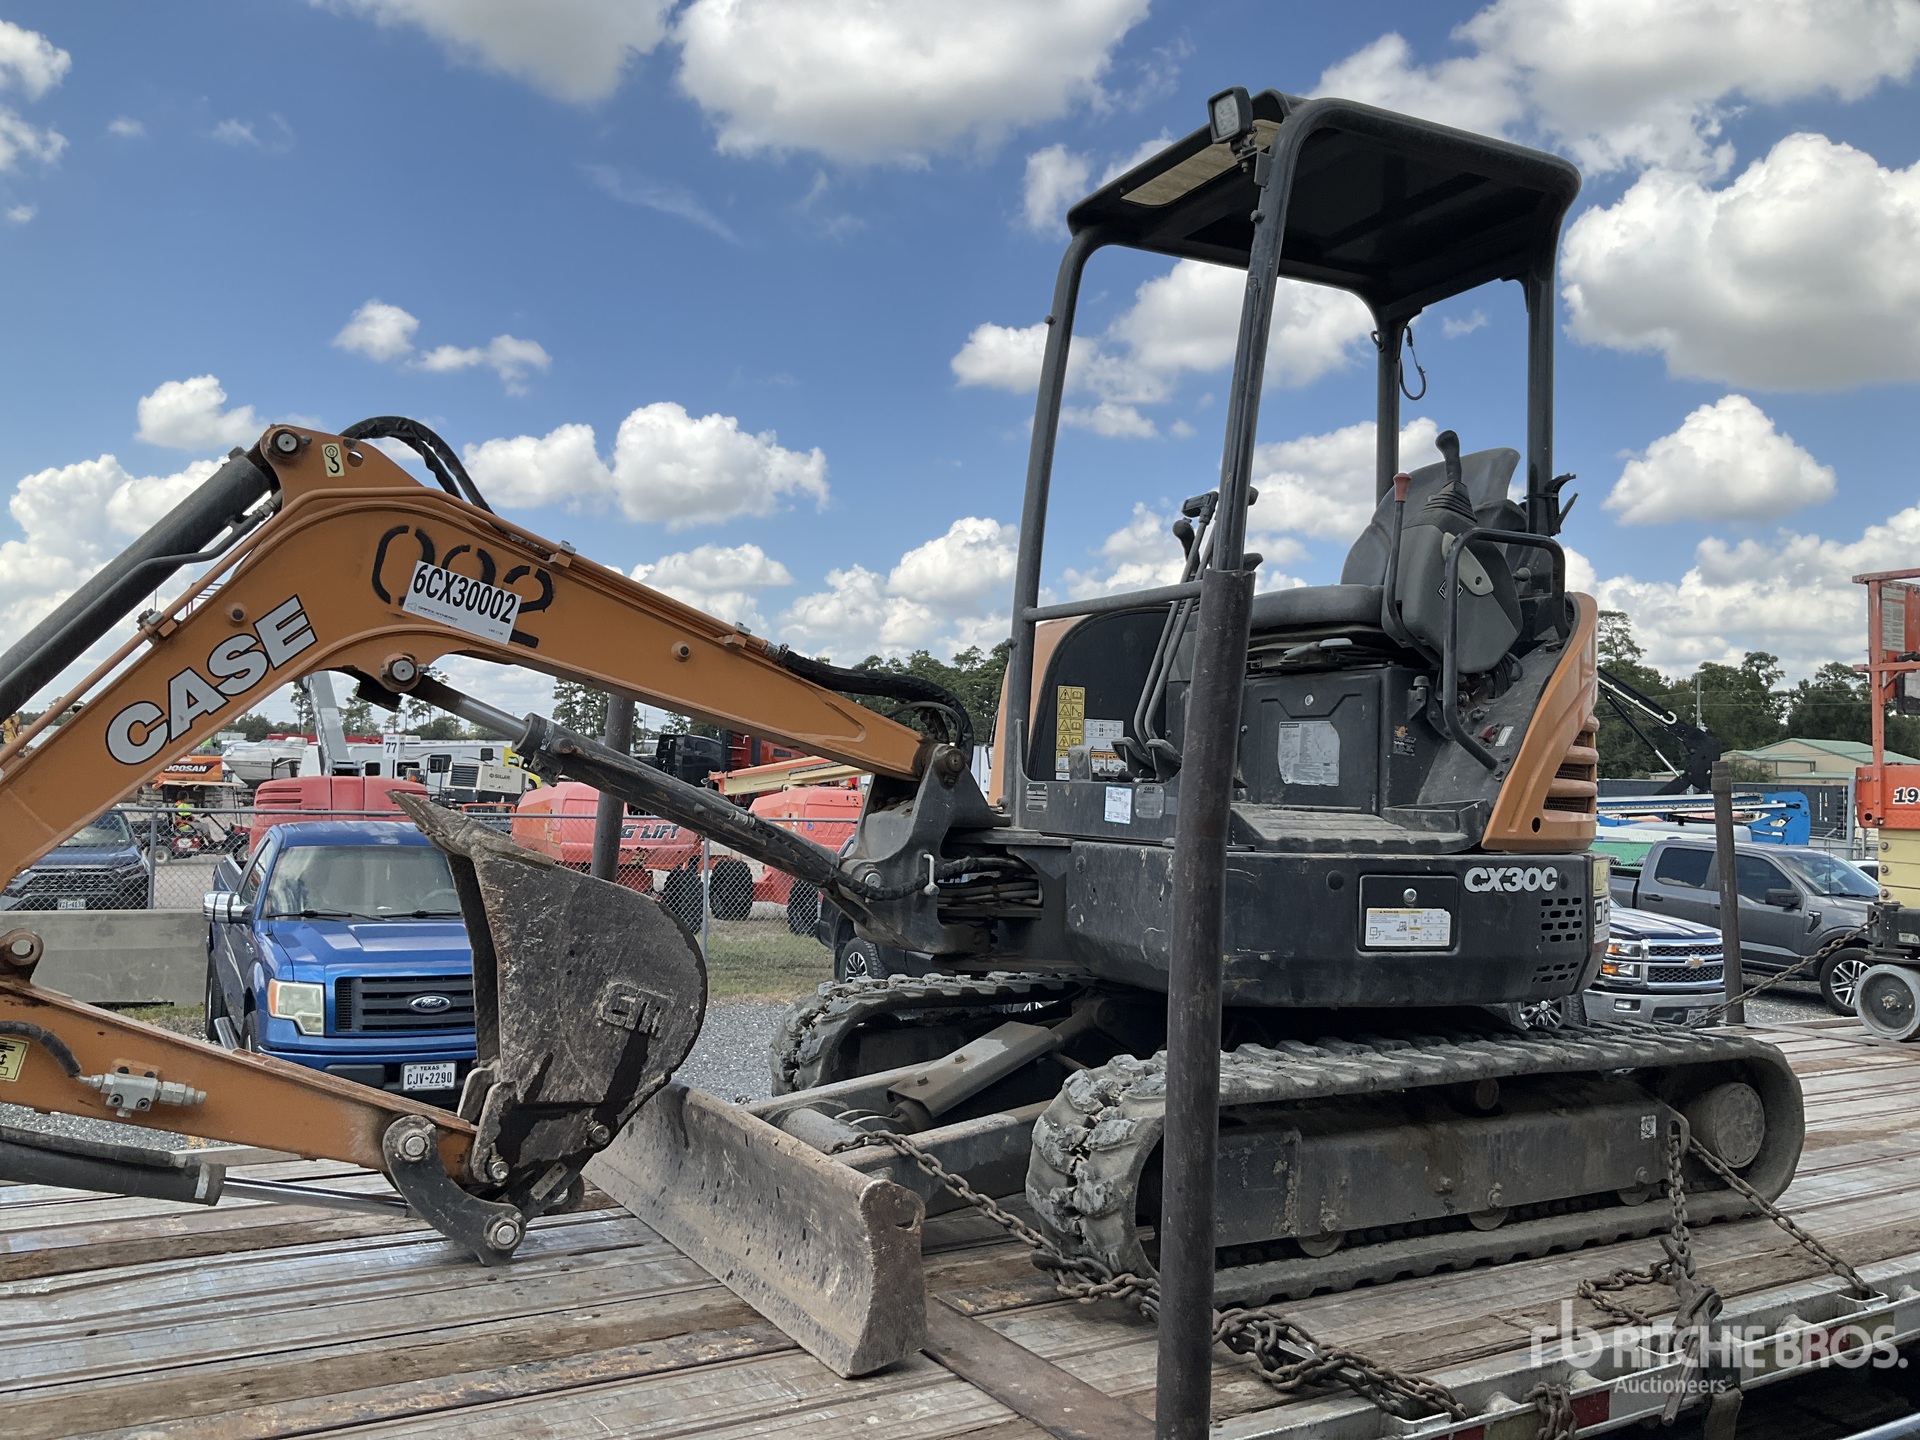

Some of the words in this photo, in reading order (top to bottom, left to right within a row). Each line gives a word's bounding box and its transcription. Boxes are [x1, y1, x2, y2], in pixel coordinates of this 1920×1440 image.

[413, 564, 517, 624] 6CX30002
[105, 593, 318, 765] CASE
[385, 742, 397, 753] 77
[1892, 786, 1920, 805] 19
[639, 823, 680, 839] LIFT
[1464, 866, 1558, 893] CX30C
